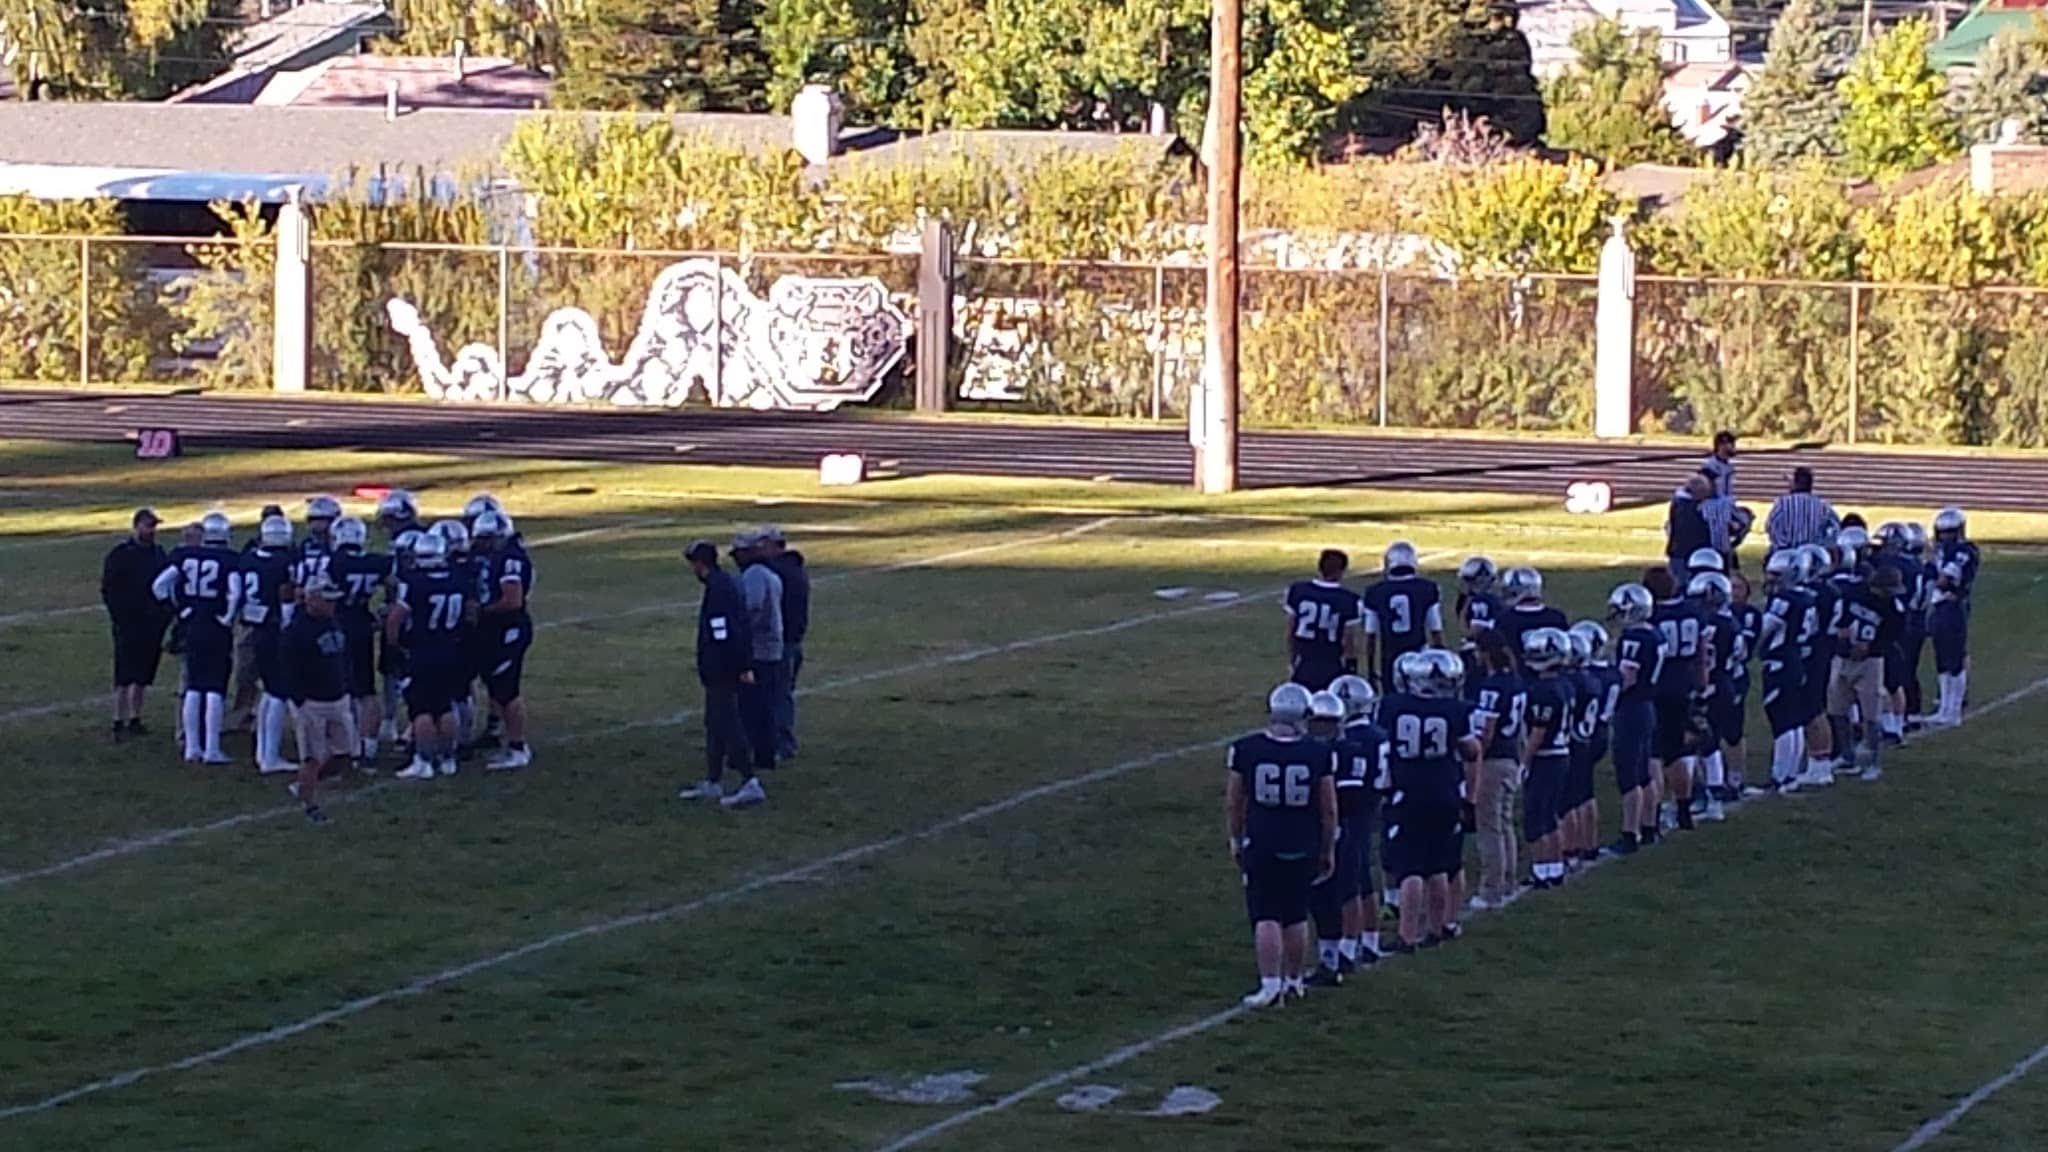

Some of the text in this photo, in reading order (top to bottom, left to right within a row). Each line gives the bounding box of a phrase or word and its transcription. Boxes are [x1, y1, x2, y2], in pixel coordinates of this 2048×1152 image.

[138, 431, 170, 456] 10
[183, 558, 220, 597] 32
[429, 594, 463, 630] 70
[1296, 600, 1339, 642] 24
[1390, 594, 1411, 632] 3
[1397, 714, 1448, 757] 93
[1255, 763, 1310, 806] 66
